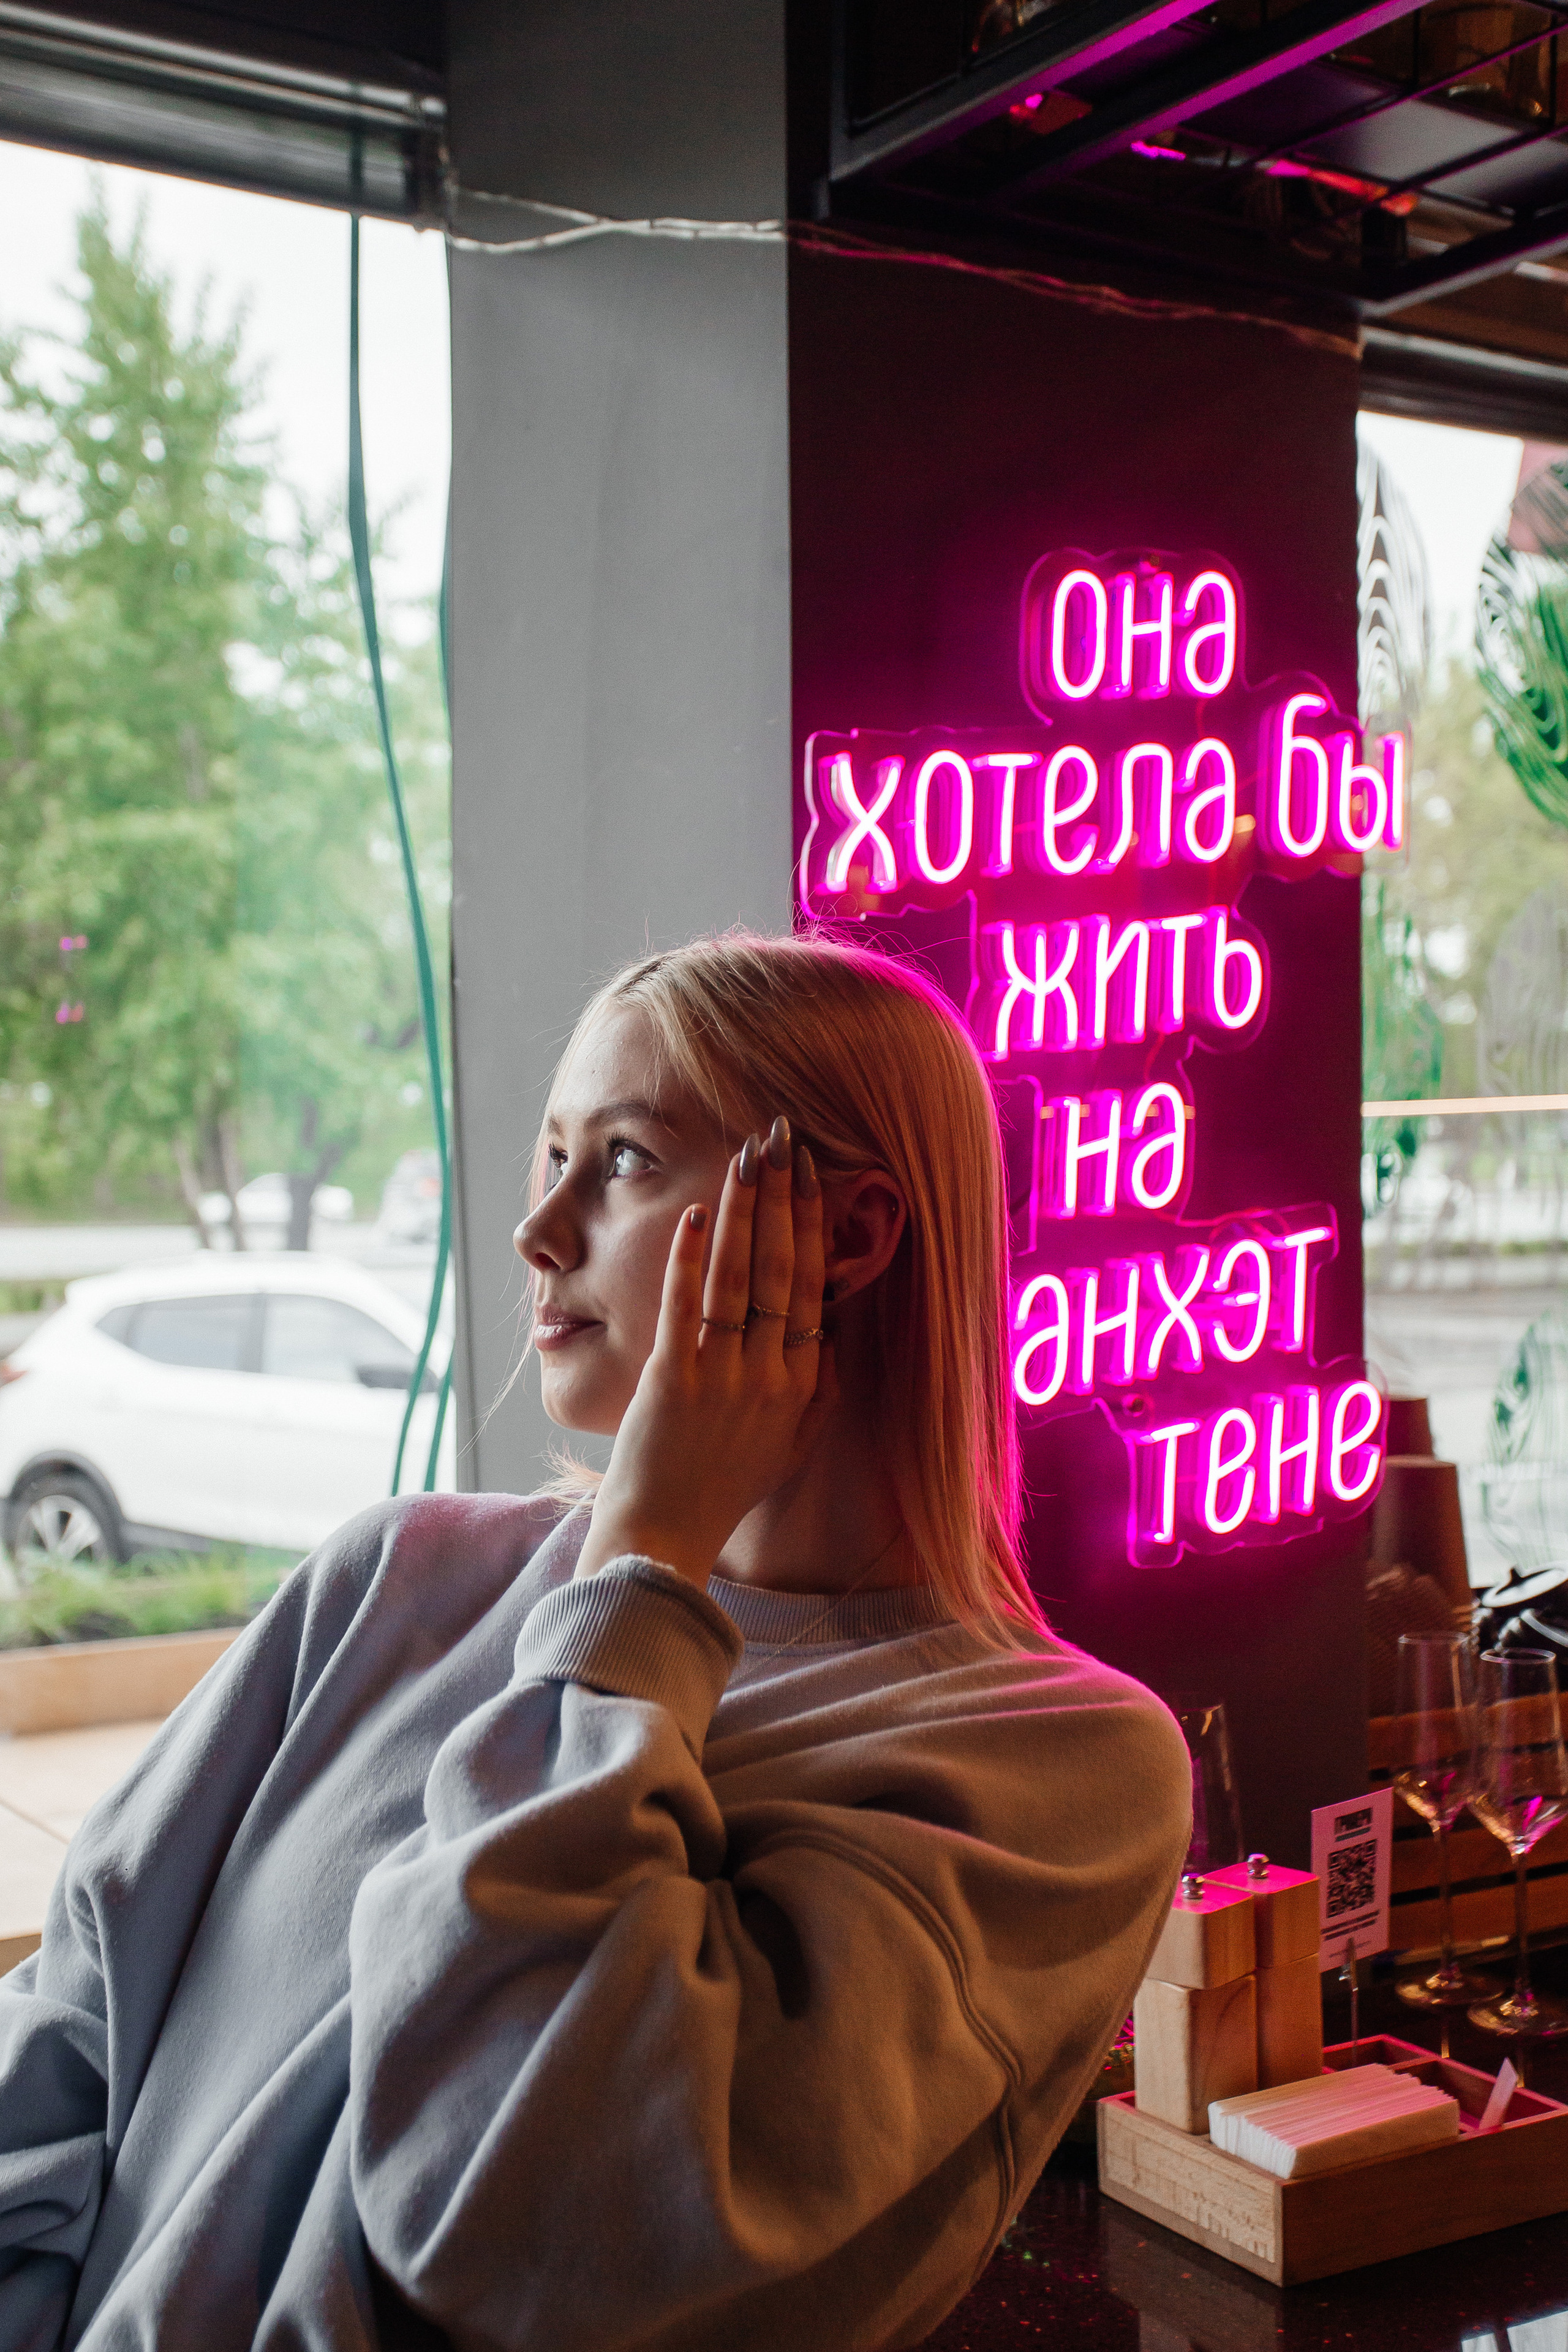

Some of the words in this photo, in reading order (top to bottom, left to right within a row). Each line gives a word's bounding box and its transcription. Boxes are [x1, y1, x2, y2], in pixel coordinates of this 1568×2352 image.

[1050, 570, 1236, 699] она
[827, 737, 1236, 891] хотела
[1277, 693, 1404, 856] бы
[995, 913, 1263, 1061] жить
[1061, 1082, 1186, 1218] на
[1013, 1226, 1333, 1406] анхэт
[1145, 1380, 1382, 1544] тене
